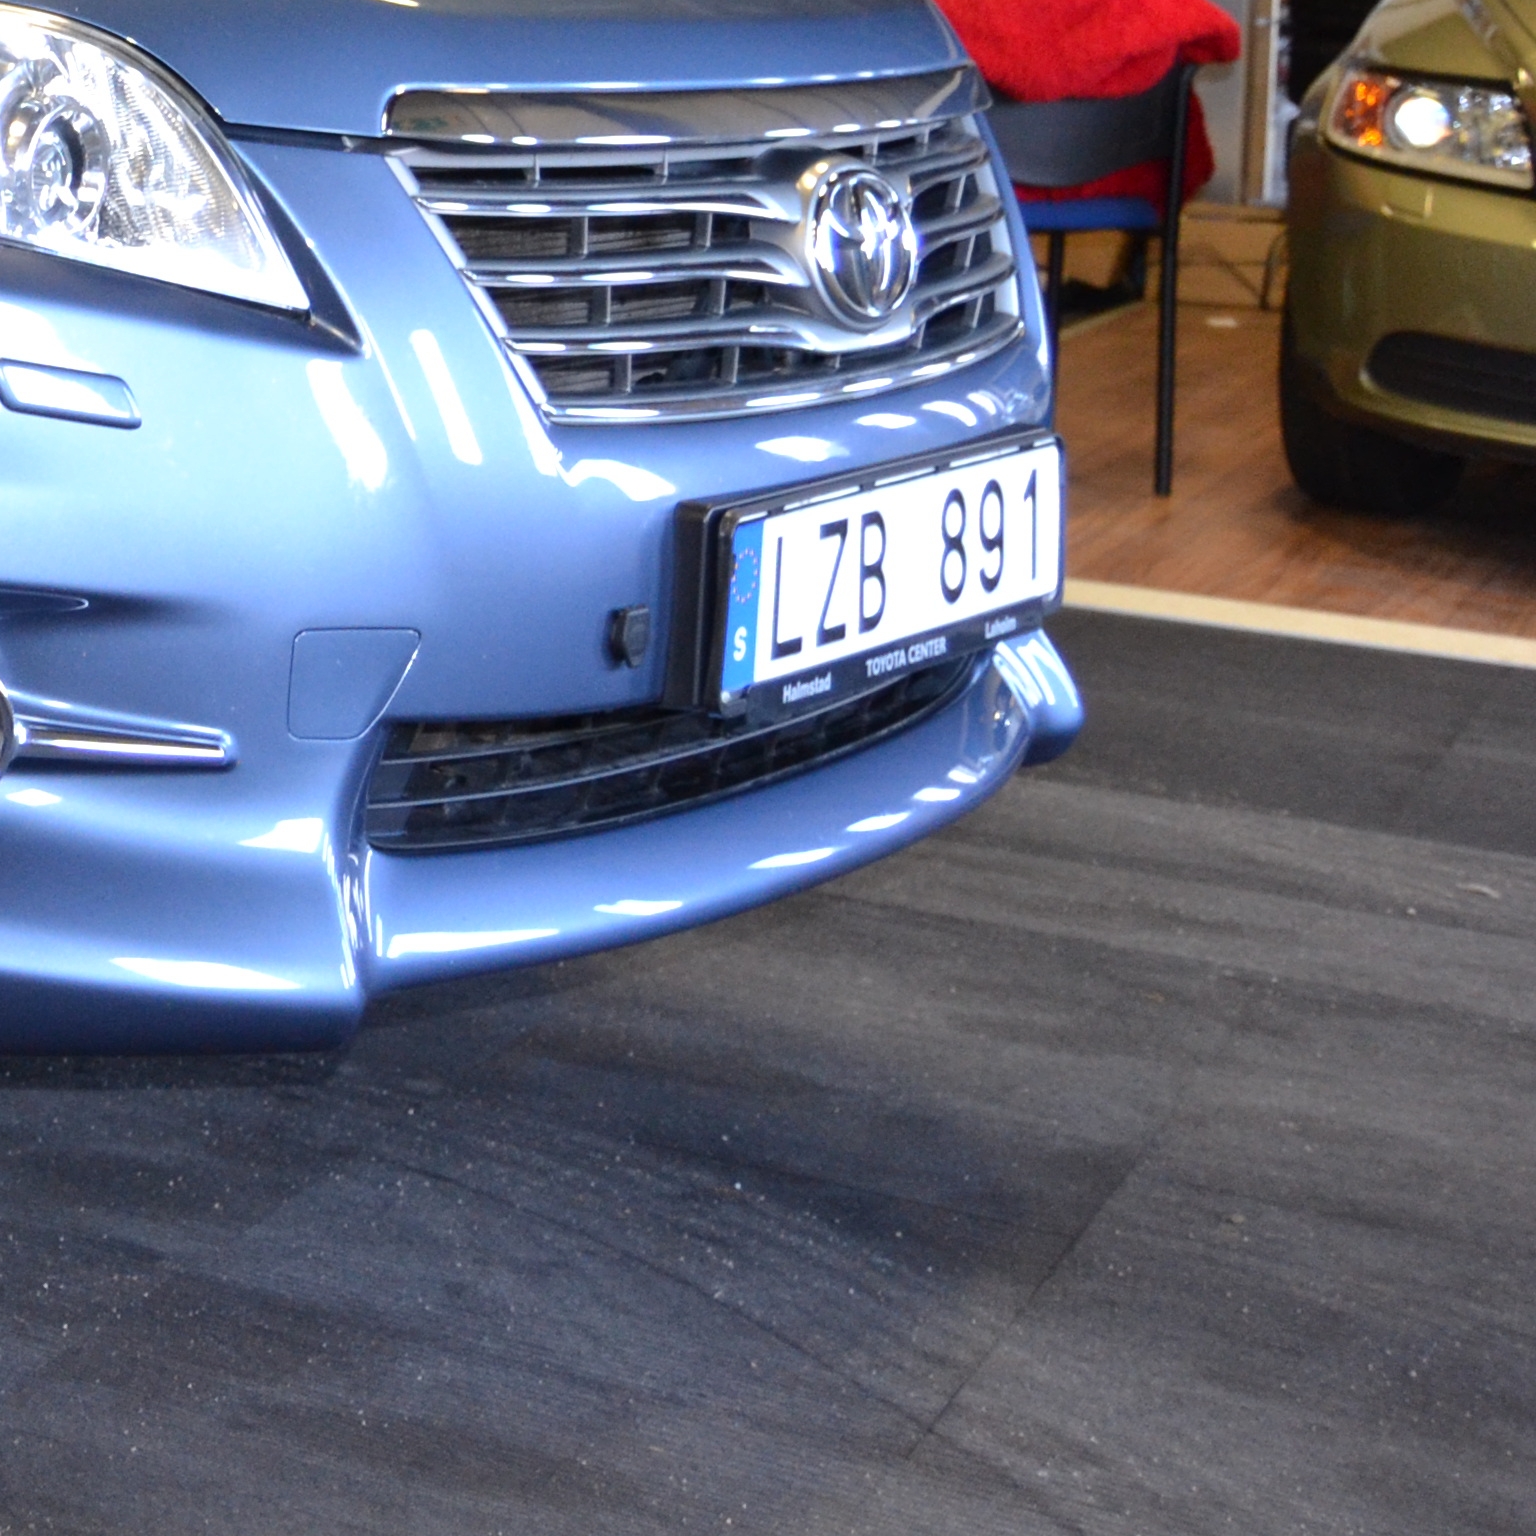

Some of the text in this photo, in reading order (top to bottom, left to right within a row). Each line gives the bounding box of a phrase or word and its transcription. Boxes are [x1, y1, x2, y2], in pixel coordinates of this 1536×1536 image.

[770, 468, 1038, 661] LZB 891
[732, 626, 747, 662] S
[782, 672, 832, 704] Halmstad
[865, 649, 907, 678] TOYOTA
[907, 636, 947, 664] CENTER
